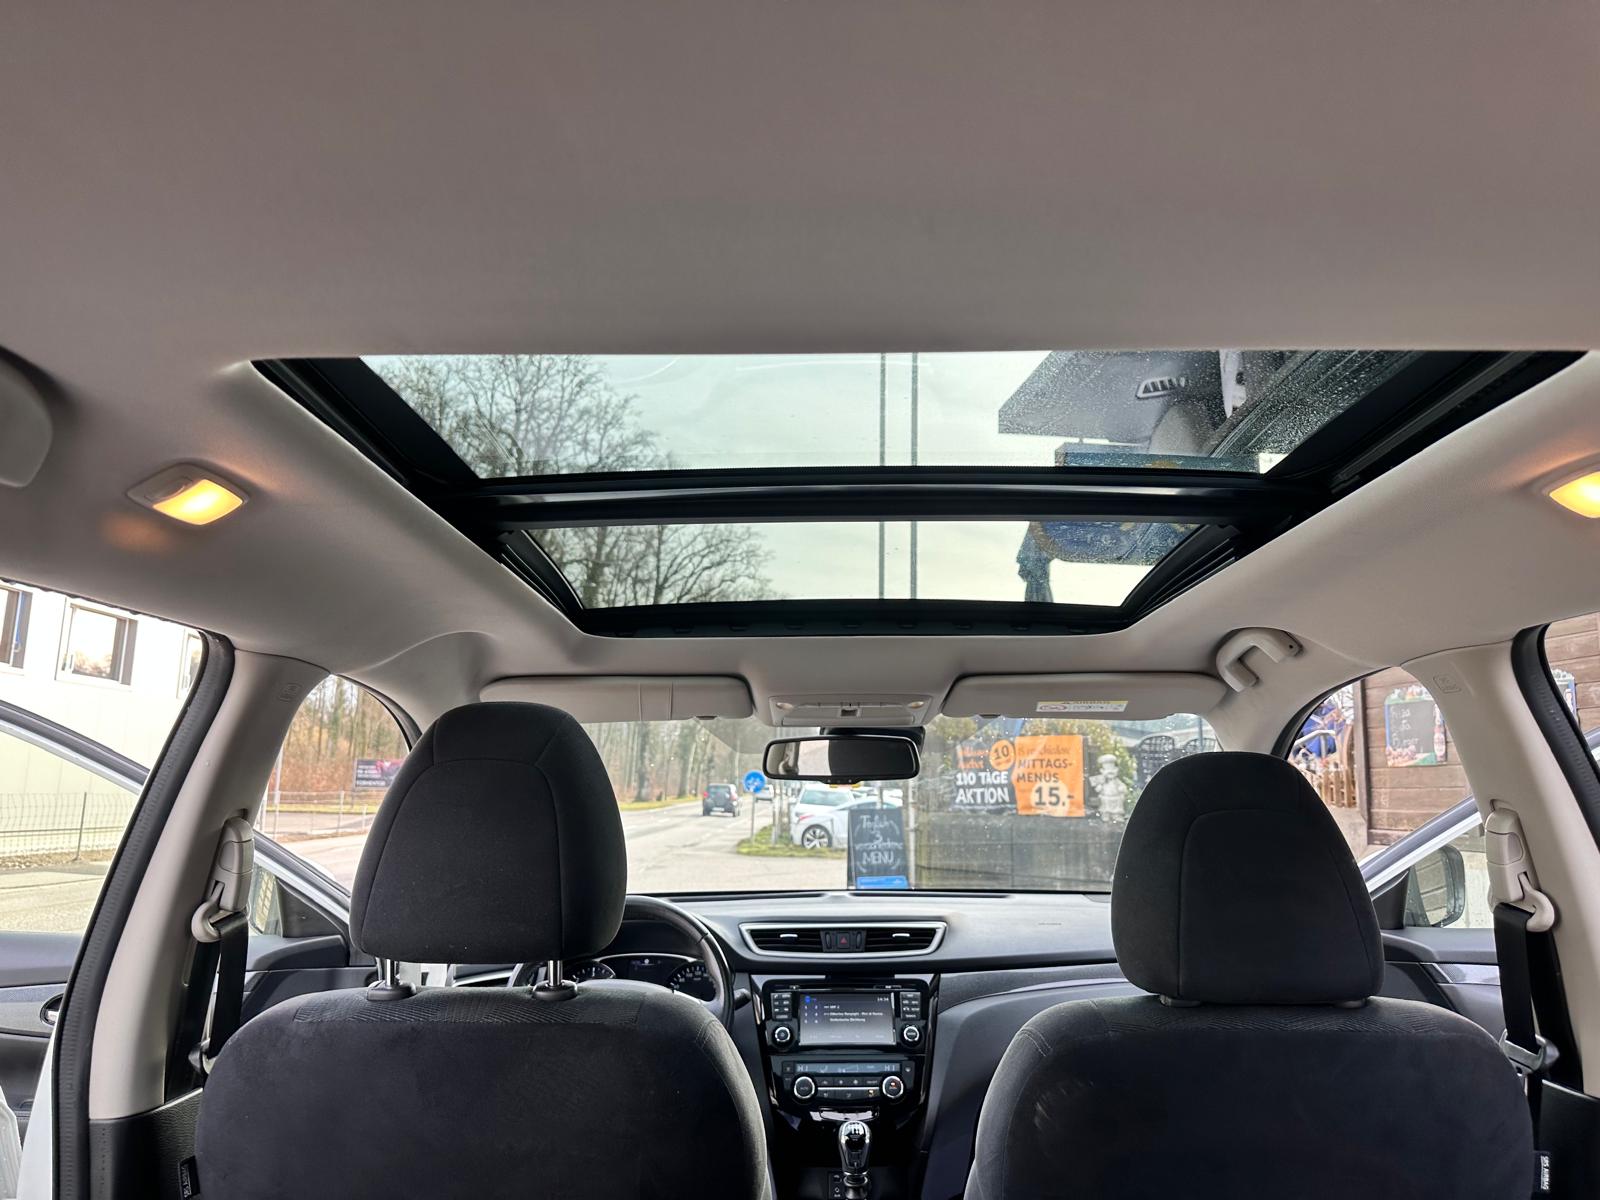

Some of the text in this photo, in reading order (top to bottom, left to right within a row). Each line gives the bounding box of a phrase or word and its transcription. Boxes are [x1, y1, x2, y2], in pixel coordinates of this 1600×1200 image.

[994, 745, 1009, 760] 10
[1018, 759, 1073, 769] MITTAGS-
[1016, 769, 1060, 783] MENÜS
[955, 787, 1010, 803] AKTION
